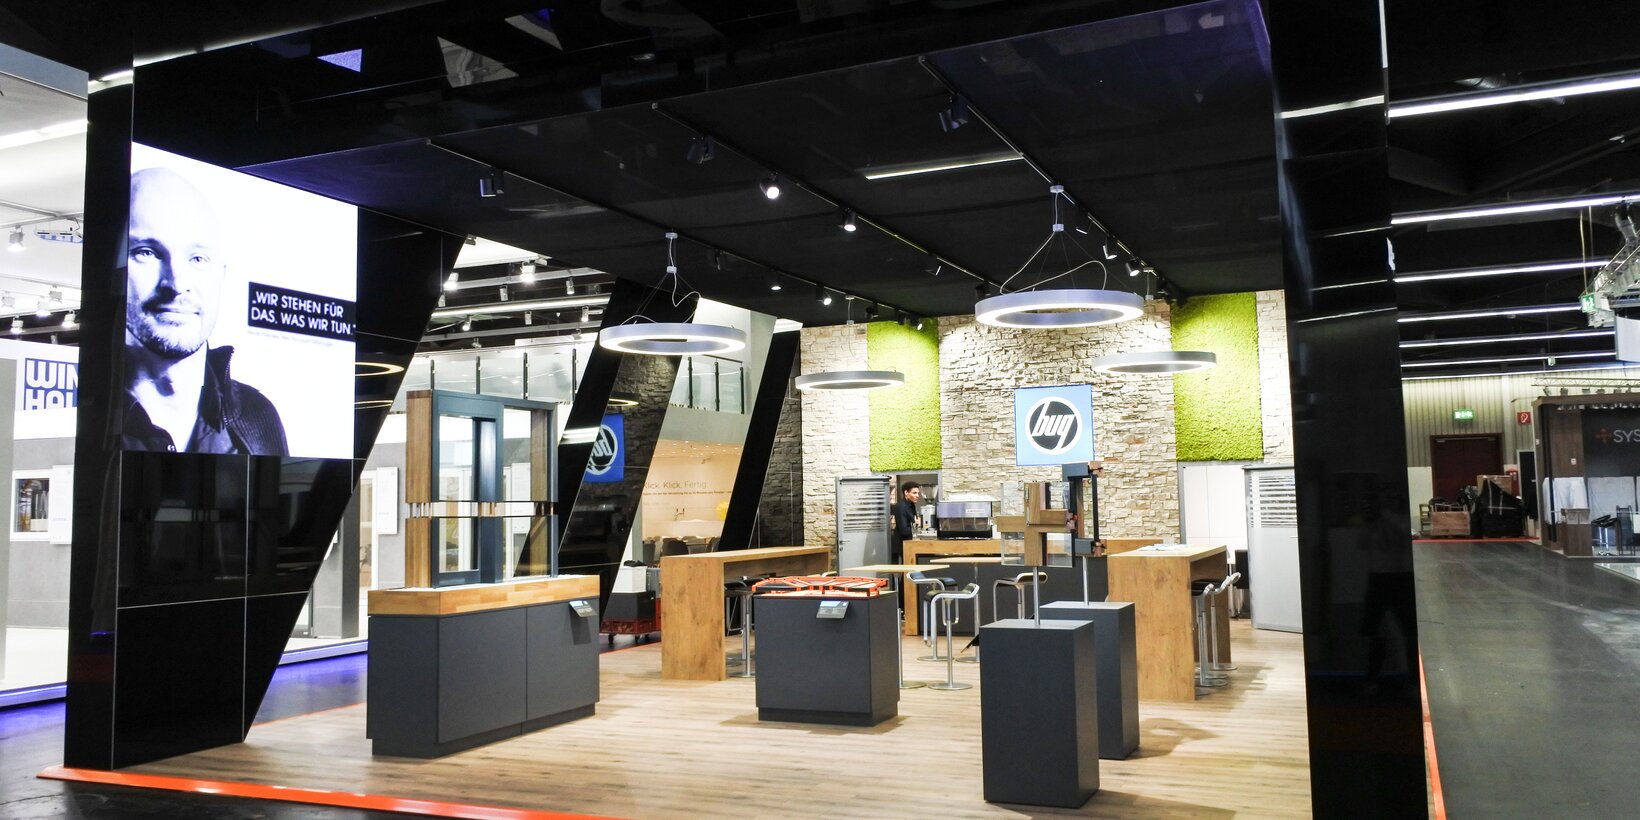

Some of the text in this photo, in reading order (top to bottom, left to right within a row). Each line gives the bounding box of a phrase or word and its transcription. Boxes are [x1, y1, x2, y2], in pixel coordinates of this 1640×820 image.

[281, 295, 321, 314] STEHEN
[324, 302, 344, 318] FÜR
[280, 312, 305, 328] WAS
[307, 317, 329, 331] WIR
